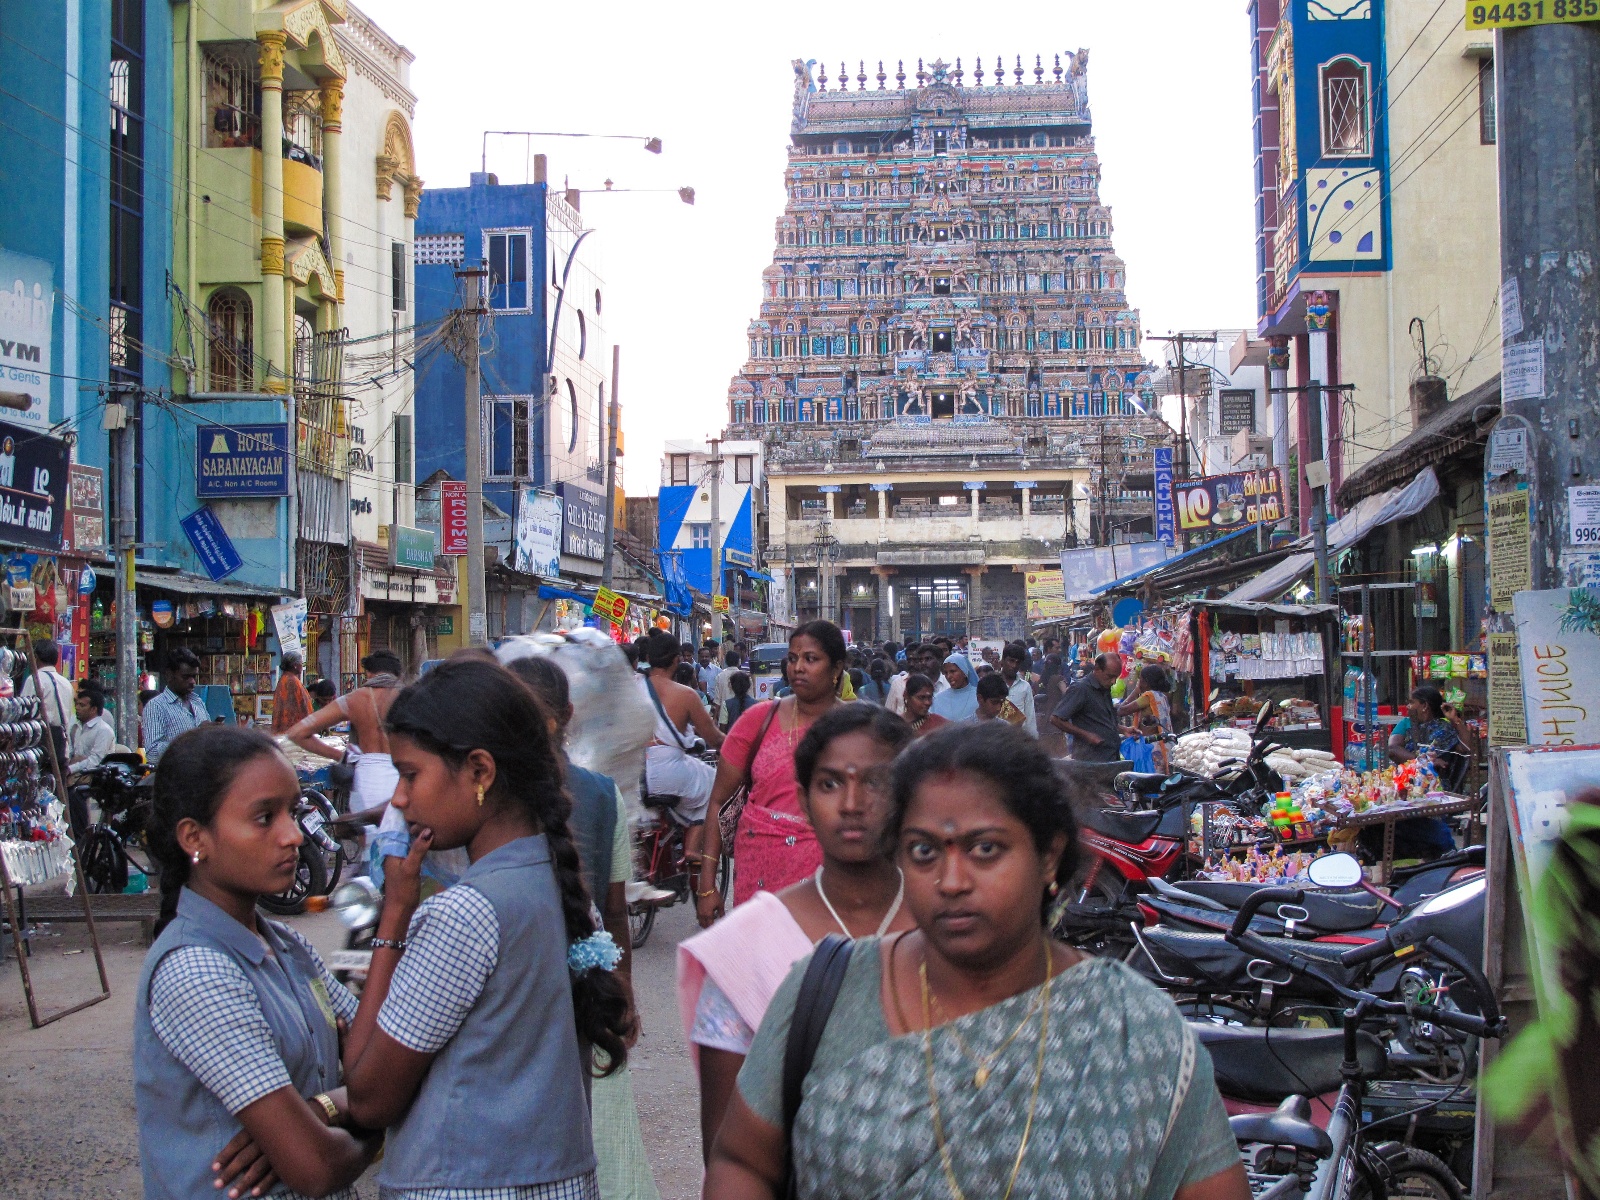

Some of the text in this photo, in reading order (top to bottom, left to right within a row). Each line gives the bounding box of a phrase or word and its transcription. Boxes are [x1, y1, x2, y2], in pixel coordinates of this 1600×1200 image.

[1473, 1, 1544, 25] 94431
[9, 369, 41, 386] Gents
[238, 433, 276, 452] HOTEL
[203, 457, 283, 476] SABANAYAGAM
[255, 479, 278, 487] Rooms
[1157, 473, 1173, 541] ARUDHRA
[28, 505, 53, 532] காபி
[451, 499, 467, 547] ROOMS
[406, 548, 433, 563] DARSHAN
[1534, 645, 1587, 720] JUICE
